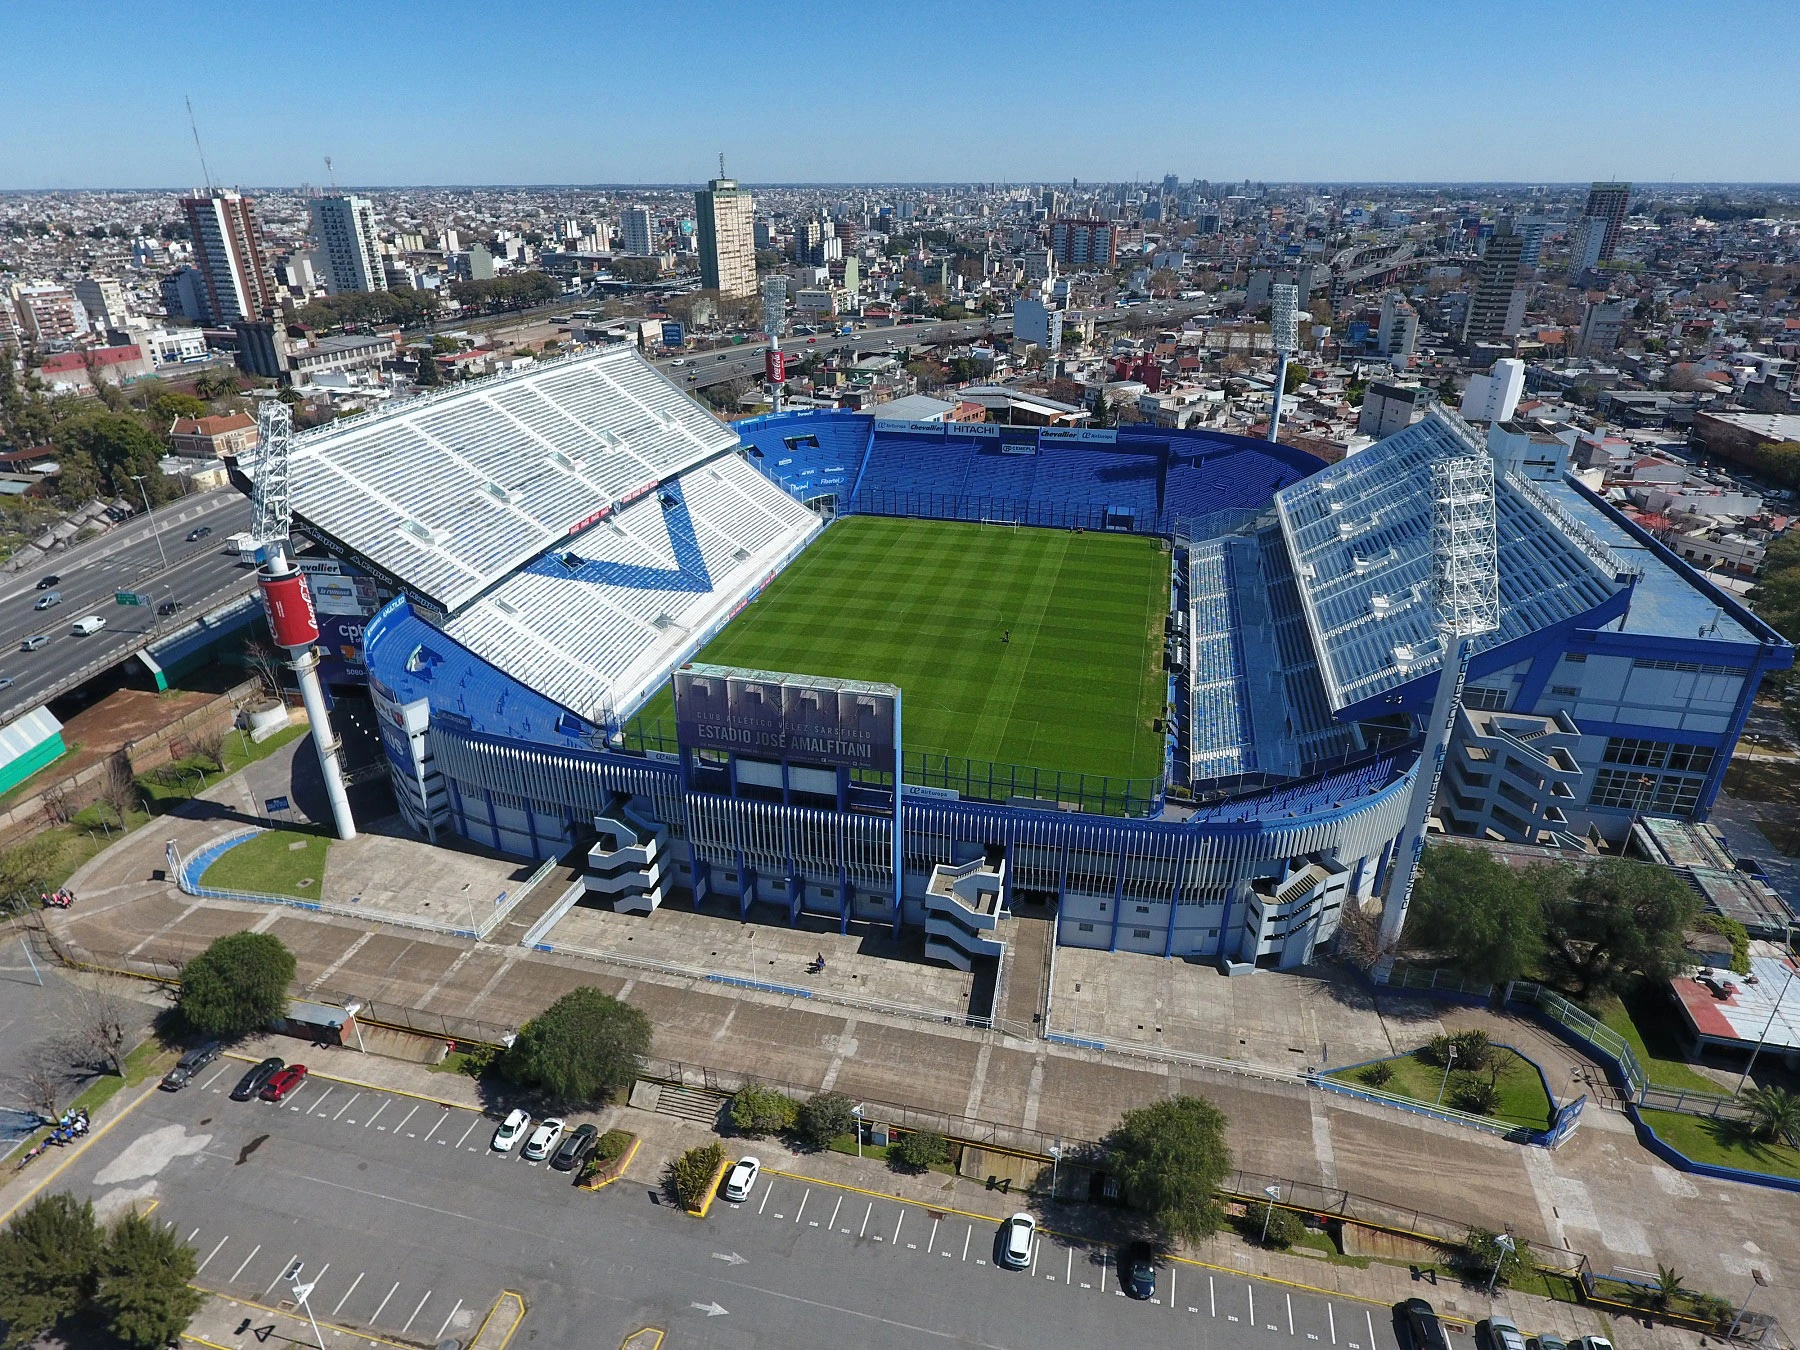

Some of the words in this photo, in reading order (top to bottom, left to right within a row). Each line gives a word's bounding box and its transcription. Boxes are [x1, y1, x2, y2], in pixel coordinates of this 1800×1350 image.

[910, 424, 944, 432] Chevallier
[953, 425, 995, 435] HITACHI
[1040, 430, 1077, 438] Chevallier
[300, 563, 338, 573] evallier
[361, 560, 393, 585] Kappa
[697, 712, 720, 721] CLUB
[814, 725, 871, 739] SARSFIELD
[698, 724, 751, 744] ESTADIO
[791, 736, 871, 758] AMALFITANI
